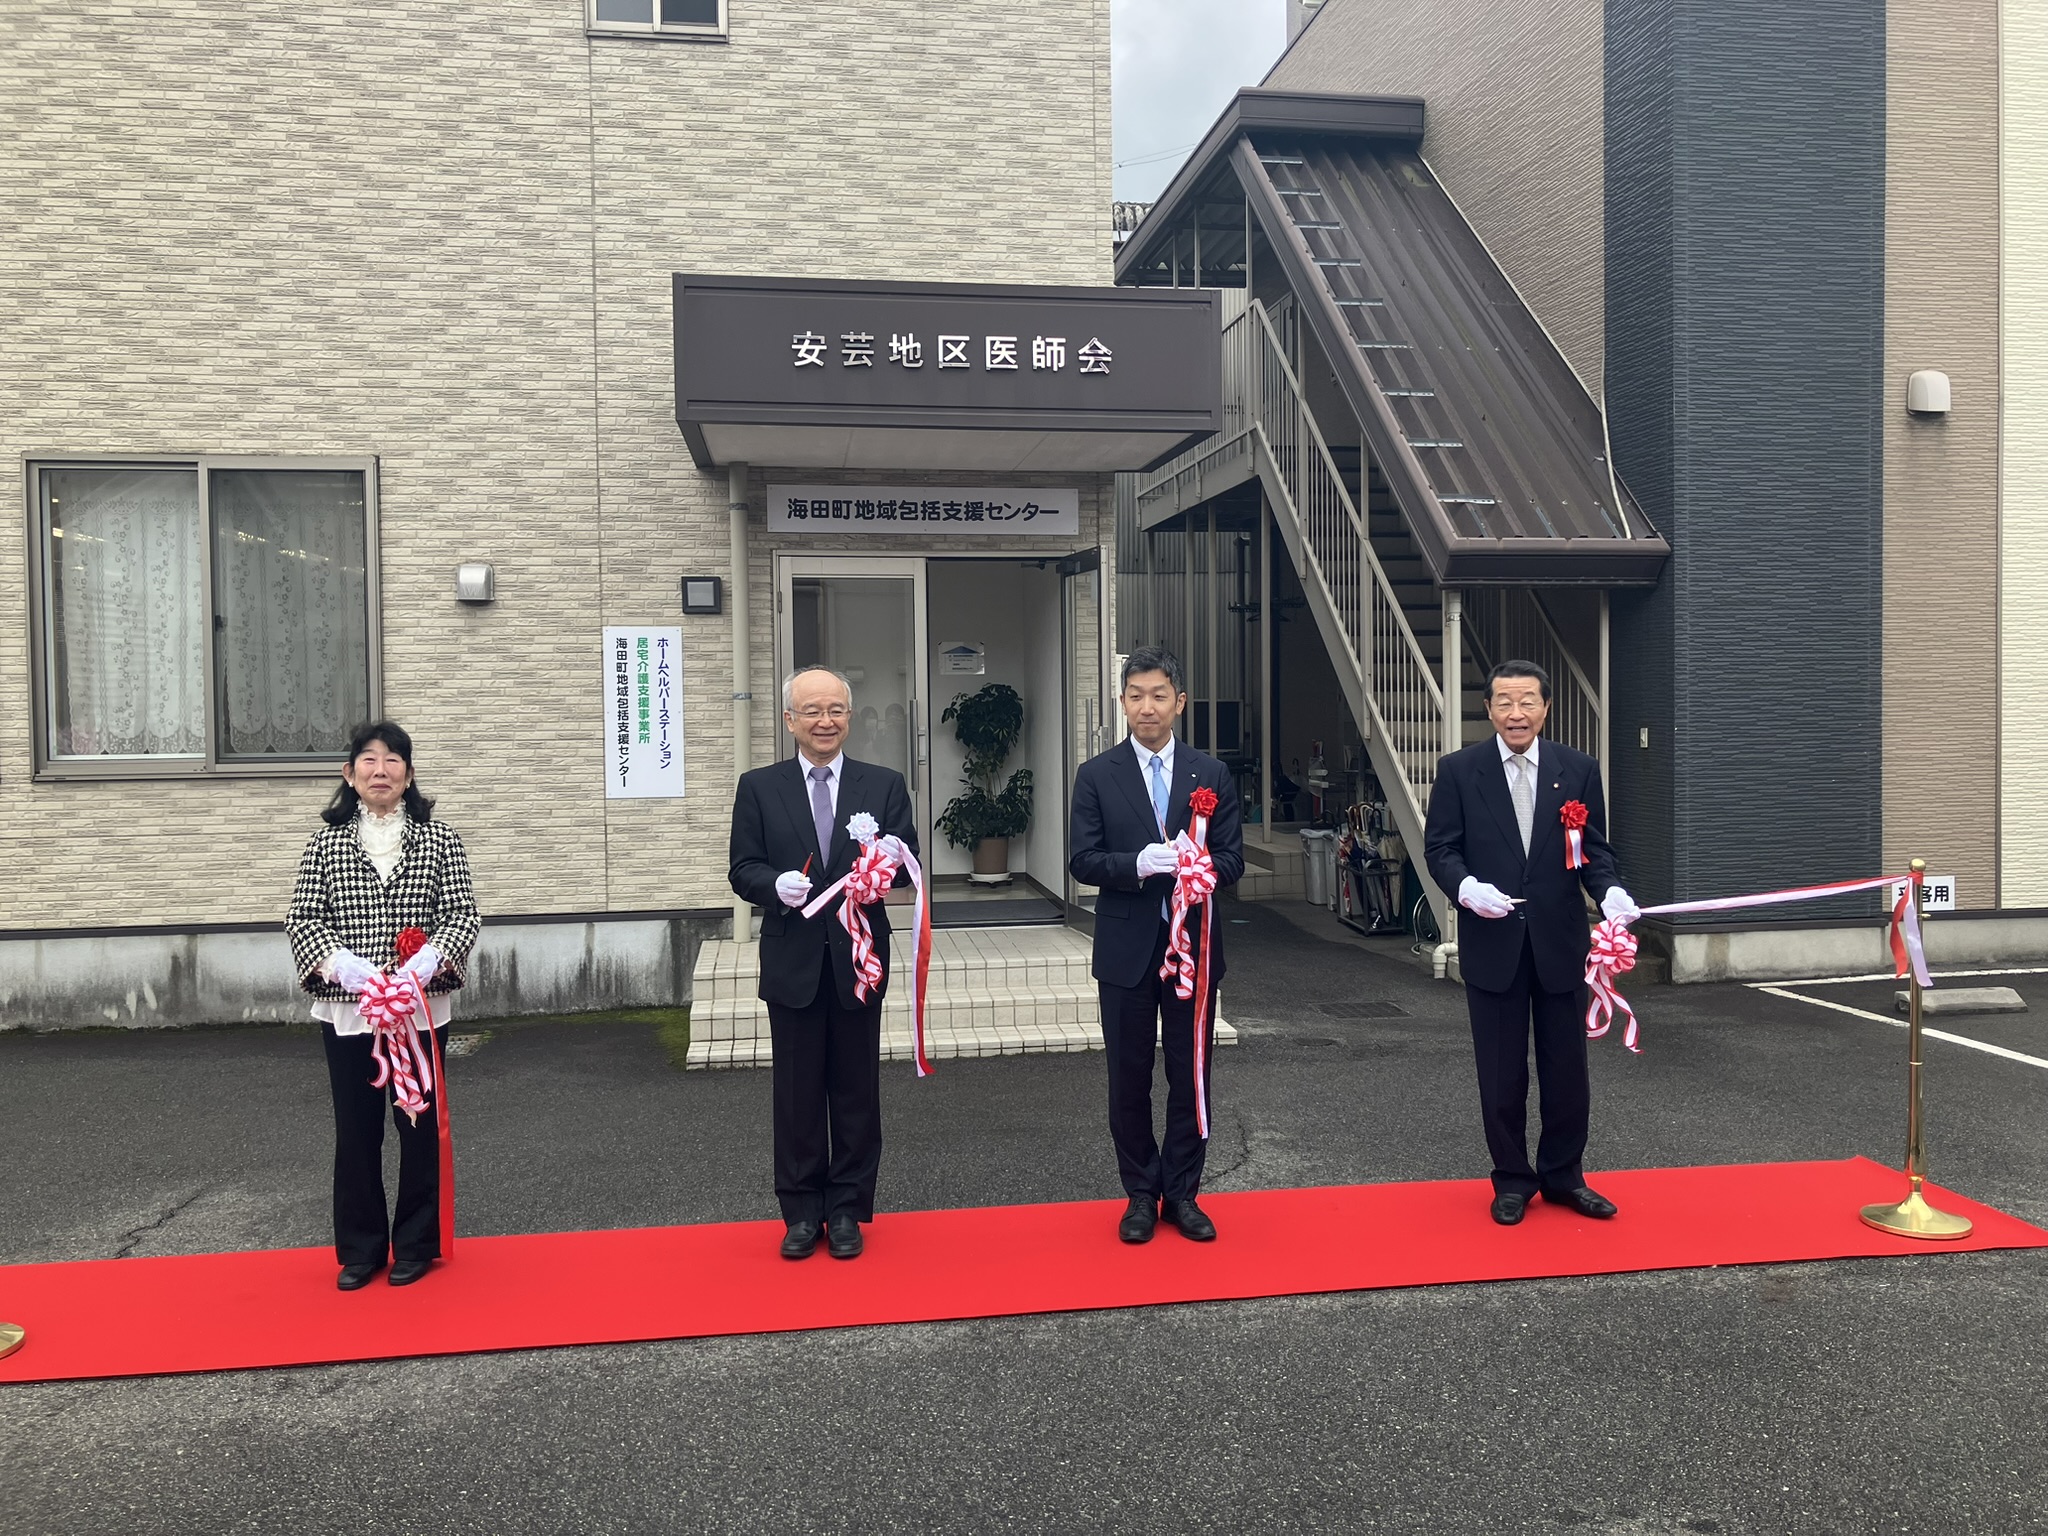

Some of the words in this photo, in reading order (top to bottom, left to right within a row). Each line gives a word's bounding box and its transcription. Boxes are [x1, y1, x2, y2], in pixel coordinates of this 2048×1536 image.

[791, 331, 1112, 374] 安芸地区医師会
[787, 498, 1060, 522] 海田町地域包括支援センター
[616, 637, 630, 788] 海田町地域包括支援センター
[636, 637, 650, 744] 居宅介護支援事業所
[657, 637, 672, 769] ホームヘルパーステーション
